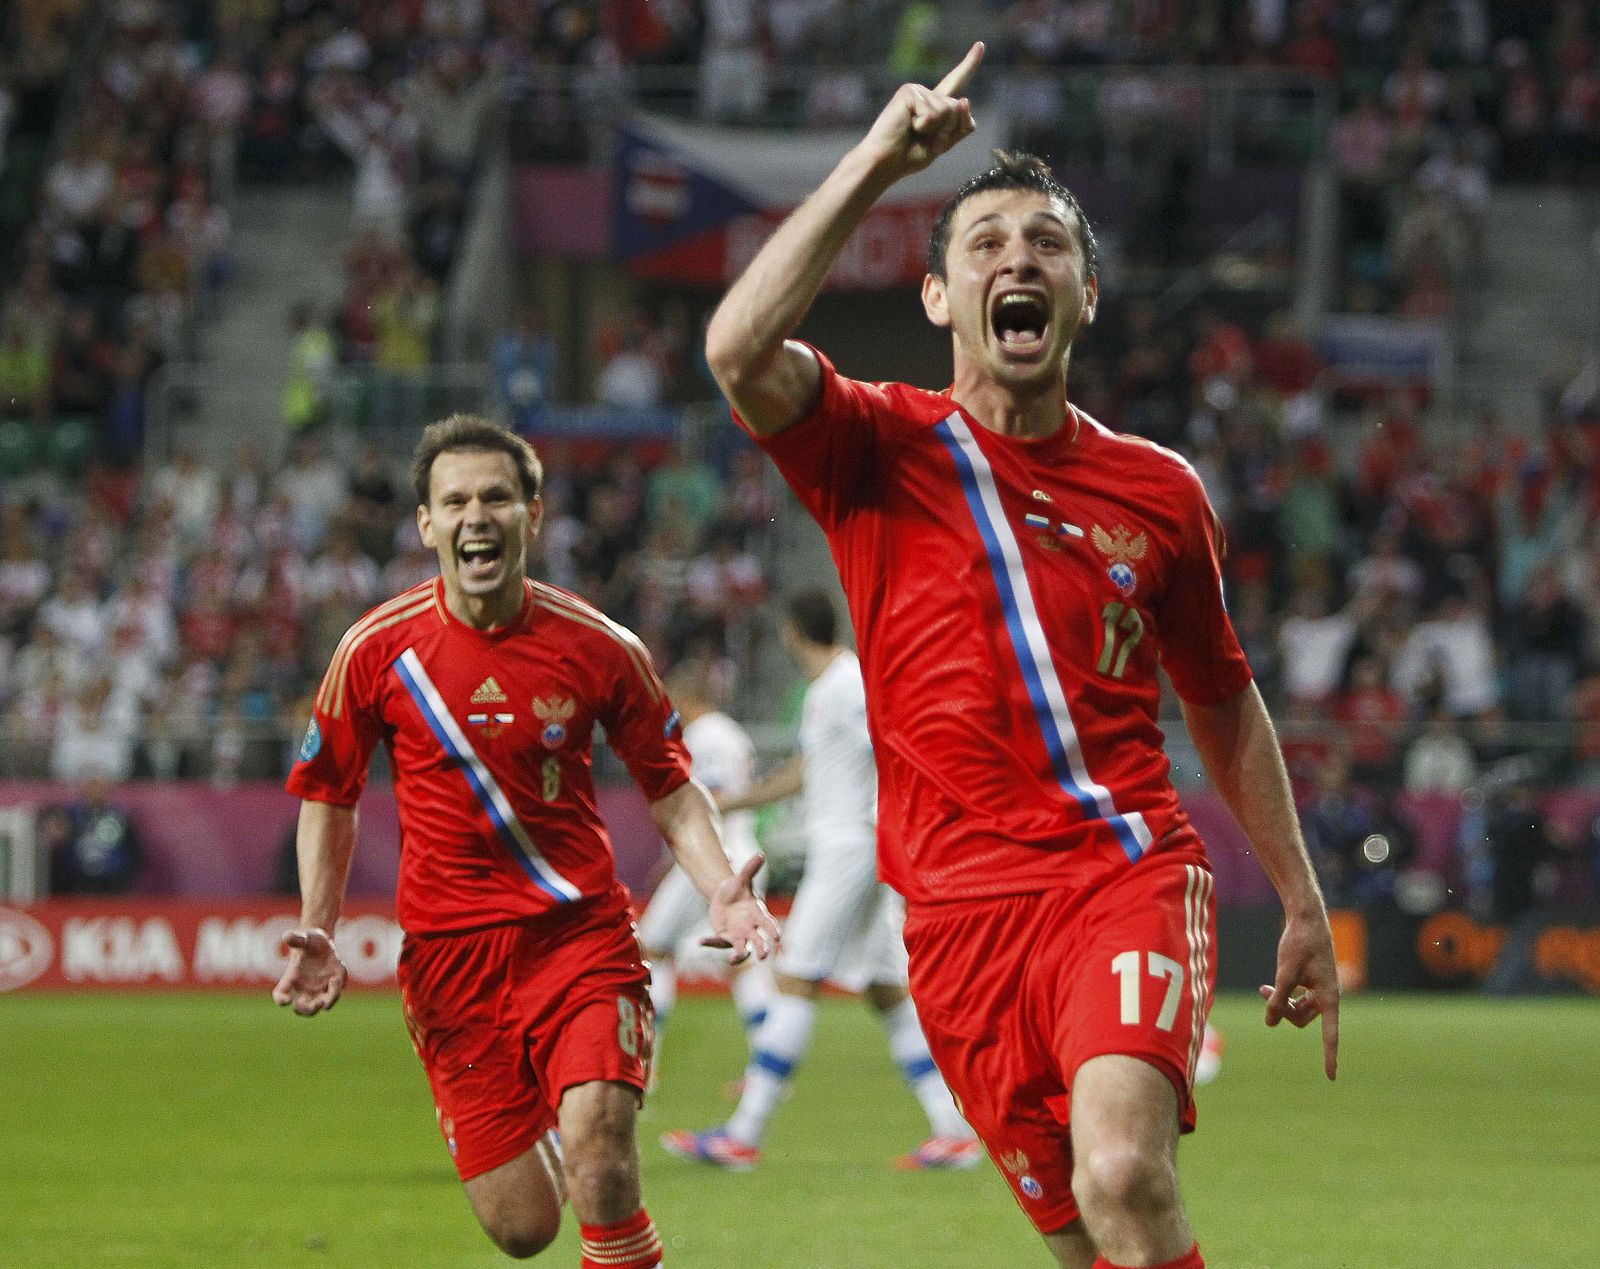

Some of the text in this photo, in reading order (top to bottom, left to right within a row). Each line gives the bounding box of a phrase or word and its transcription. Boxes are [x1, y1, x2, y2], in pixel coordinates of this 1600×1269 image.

[1096, 601, 1145, 679] 17
[62, 916, 184, 983] KIA
[617, 995, 638, 1057] 8
[1111, 950, 1184, 1033] 17
